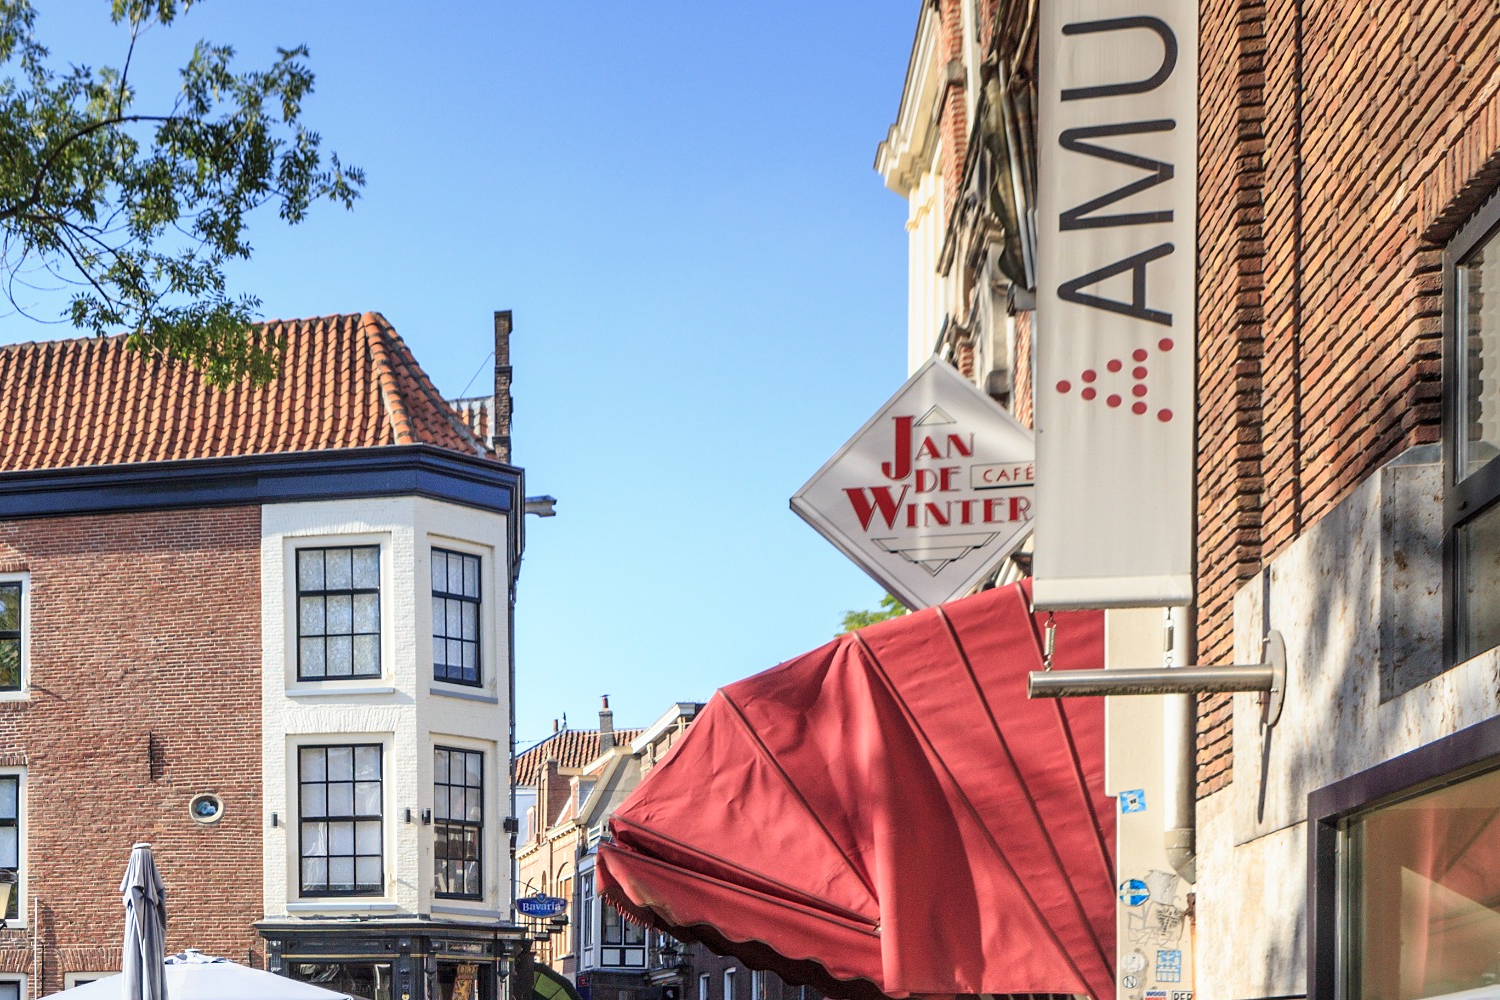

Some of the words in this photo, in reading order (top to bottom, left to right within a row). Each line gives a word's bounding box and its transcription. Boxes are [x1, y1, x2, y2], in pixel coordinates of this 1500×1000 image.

[913, 465, 963, 494] DE
[982, 463, 1035, 484] CAFÉ
[840, 484, 1033, 533] WINTER
[522, 902, 561, 912] Bavaria
